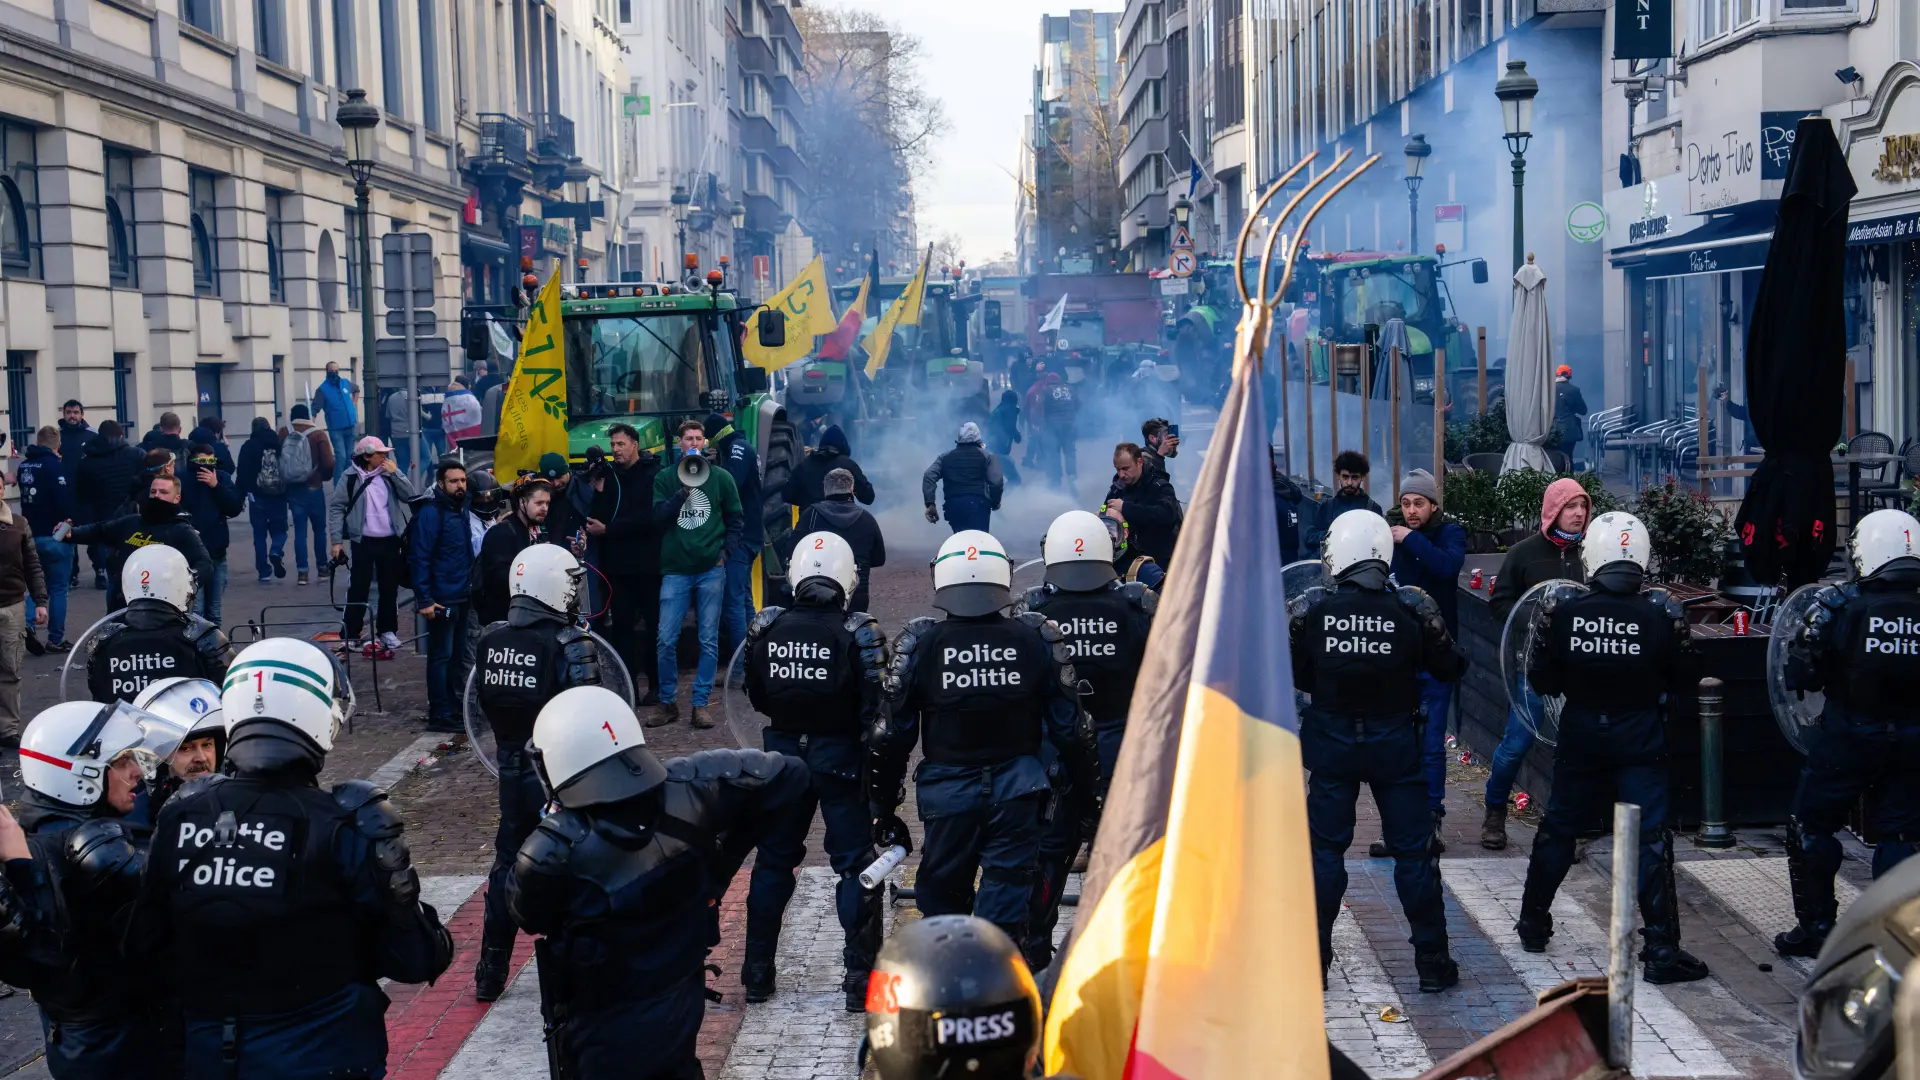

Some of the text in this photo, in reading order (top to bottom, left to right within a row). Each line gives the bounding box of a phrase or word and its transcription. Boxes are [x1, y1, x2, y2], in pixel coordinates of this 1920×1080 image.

[1895, 220, 1907, 236] Bar
[1908, 219, 1914, 234] &
[814, 538, 824, 550] 2
[1620, 532, 1630, 547] 2
[1903, 529, 1911, 543] 1
[967, 546, 977, 561] 2
[1075, 538, 1084, 553] 2
[141, 570, 150, 585] 2
[516, 563, 525, 576] 2
[1324, 614, 1395, 633] Politie
[1572, 616, 1640, 635] Police
[1869, 617, 1920, 635] Polic
[768, 642, 831, 660] Politie
[1066, 640, 1116, 657] olice
[1326, 636, 1392, 654] Police
[1570, 636, 1641, 655] Politie
[1865, 637, 1920, 655] Polit
[109, 653, 176, 673] Politie
[487, 648, 537, 667] Police
[943, 644, 1017, 665] Police
[484, 669, 537, 688] Politie
[769, 662, 828, 680] Police
[942, 667, 1021, 689] Politie
[254, 670, 263, 693] 1
[602, 720, 616, 741] 1
[177, 822, 286, 851] Potie
[937, 1011, 1016, 1045] PRESS
